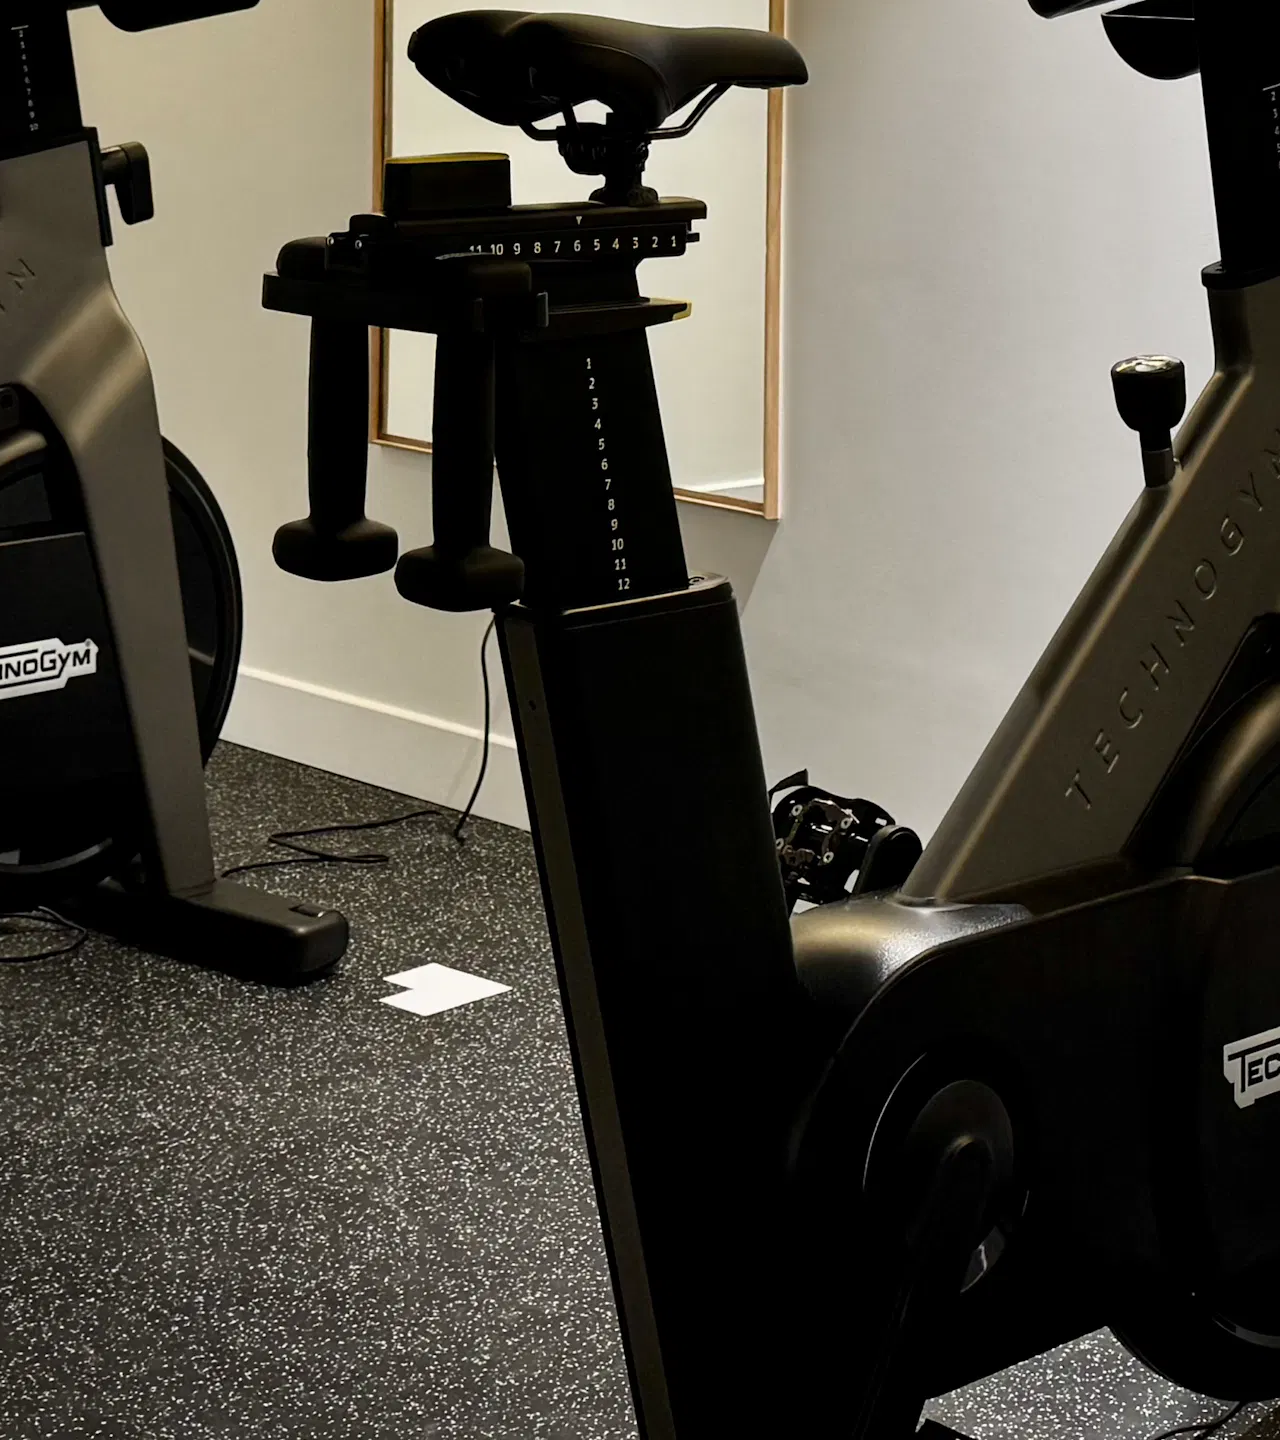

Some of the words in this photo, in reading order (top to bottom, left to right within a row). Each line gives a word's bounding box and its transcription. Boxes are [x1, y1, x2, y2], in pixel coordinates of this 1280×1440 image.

[490, 243, 504, 255] 10
[513, 243, 521, 255] 9
[533, 242, 541, 254] 8
[554, 241, 561, 253] 7
[573, 240, 581, 252] 6
[593, 239, 601, 251] 5
[612, 238, 620, 250] 4
[632, 237, 639, 249] 3
[652, 236, 659, 248] 2
[671, 235, 677, 247] 1
[586, 357, 592, 370] 1
[588, 377, 595, 390] 2
[592, 397, 599, 410] 3
[594, 418, 602, 430] 4
[598, 438, 605, 450] 5
[601, 458, 608, 470] 6
[604, 478, 612, 491] 7
[607, 498, 615, 511] 8
[611, 518, 618, 531] 9
[611, 538, 624, 551] 10
[614, 558, 626, 571] 11
[618, 578, 631, 591] 12
